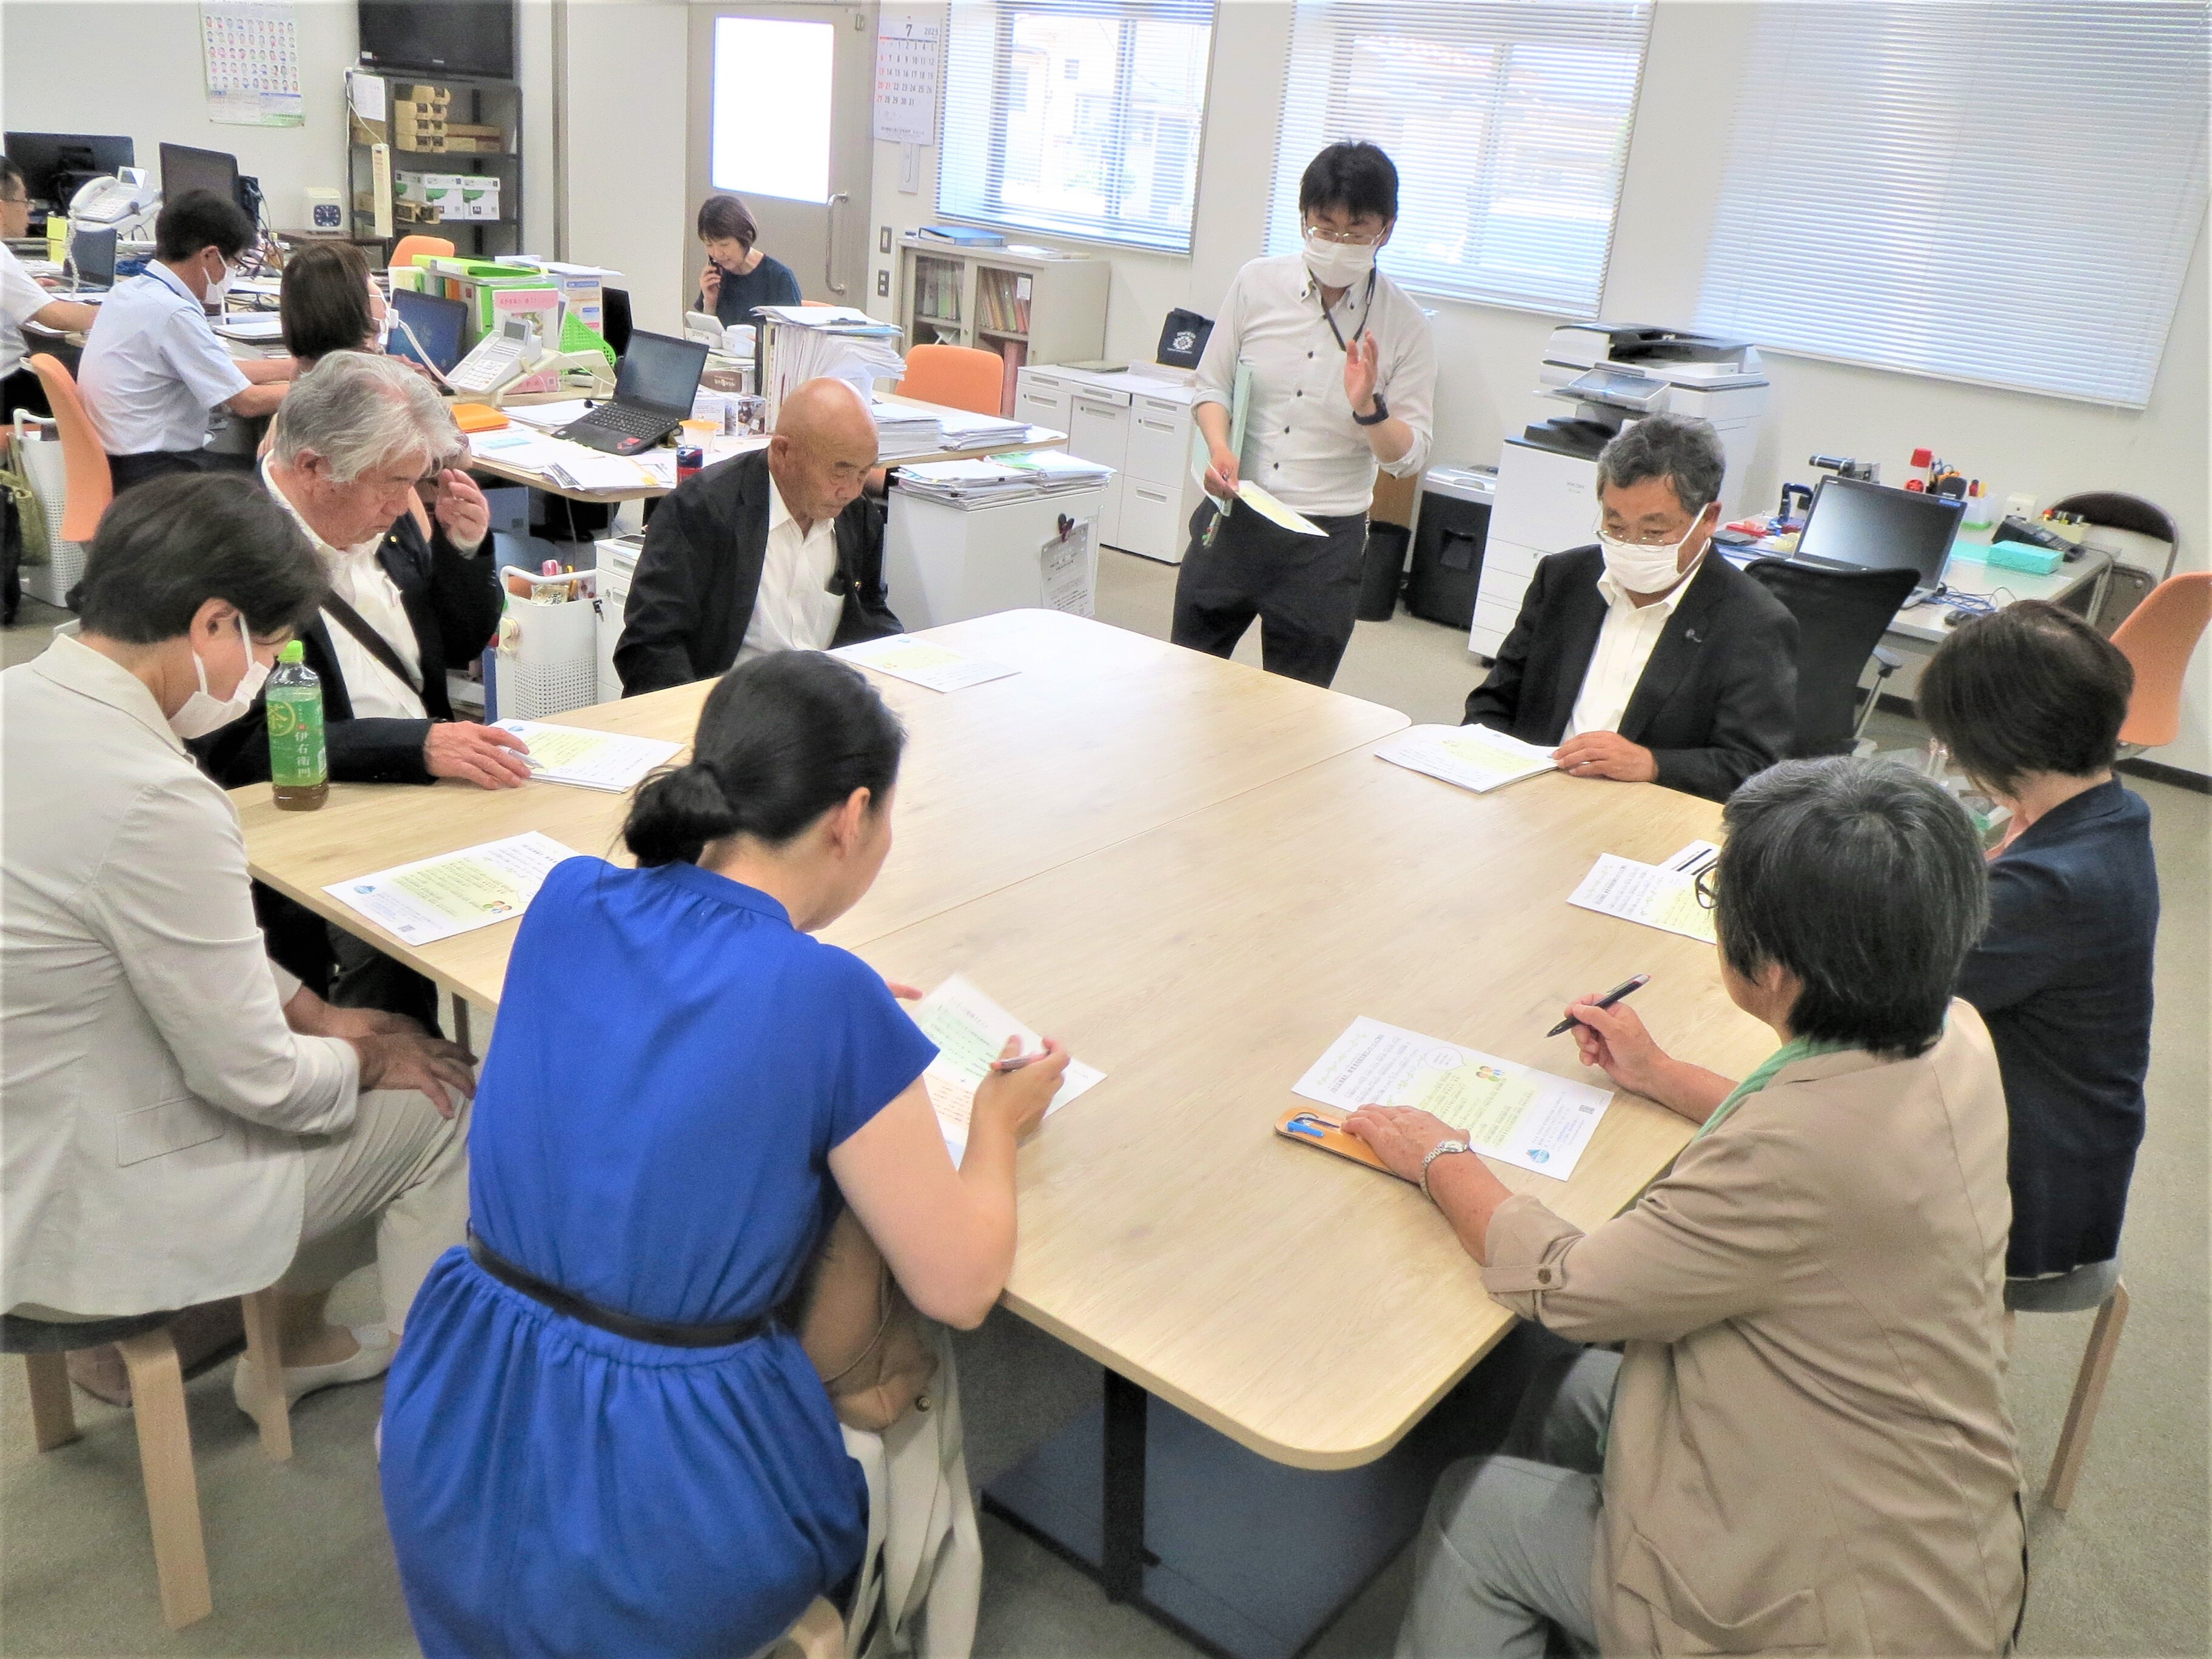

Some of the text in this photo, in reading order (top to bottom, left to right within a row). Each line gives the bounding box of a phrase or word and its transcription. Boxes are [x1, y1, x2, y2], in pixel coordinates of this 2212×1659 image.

[906, 24, 913, 37] 7
[906, 41, 909, 50] 2
[295, 731, 310, 778] 伊右衛門
